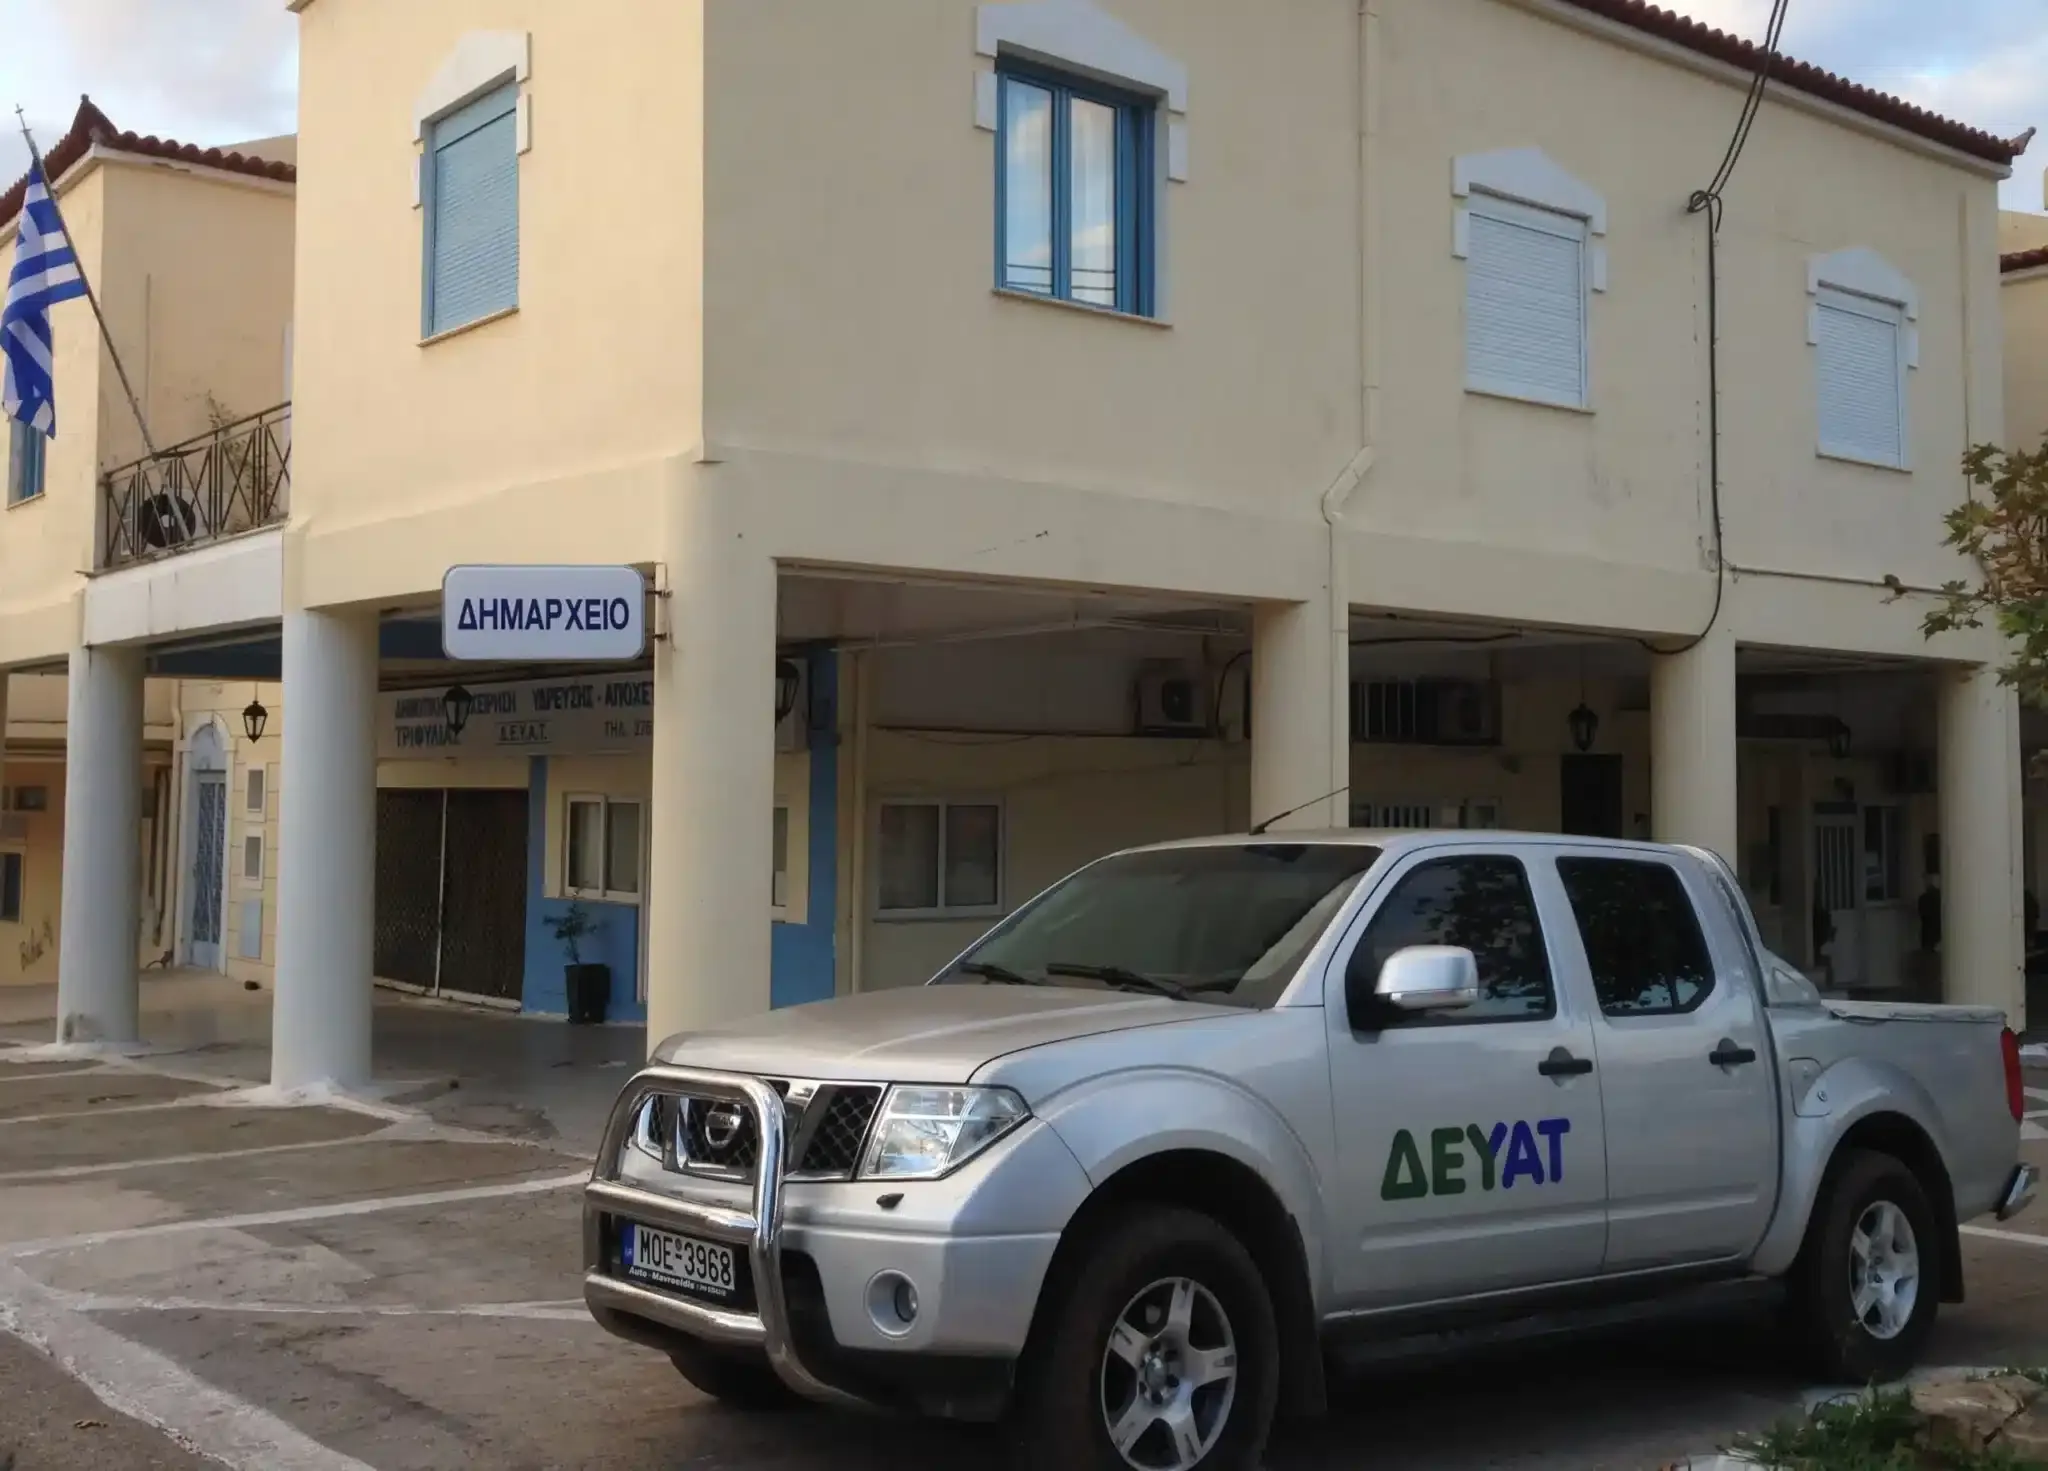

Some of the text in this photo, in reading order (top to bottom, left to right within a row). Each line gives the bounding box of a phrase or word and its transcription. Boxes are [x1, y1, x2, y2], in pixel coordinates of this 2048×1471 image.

[457, 597, 630, 631] ΔΗΜΑΡΧΕΙΟ
[1380, 1117, 1571, 1202] ΔΕΥΑΤ
[628, 1266, 648, 1279] Auto
